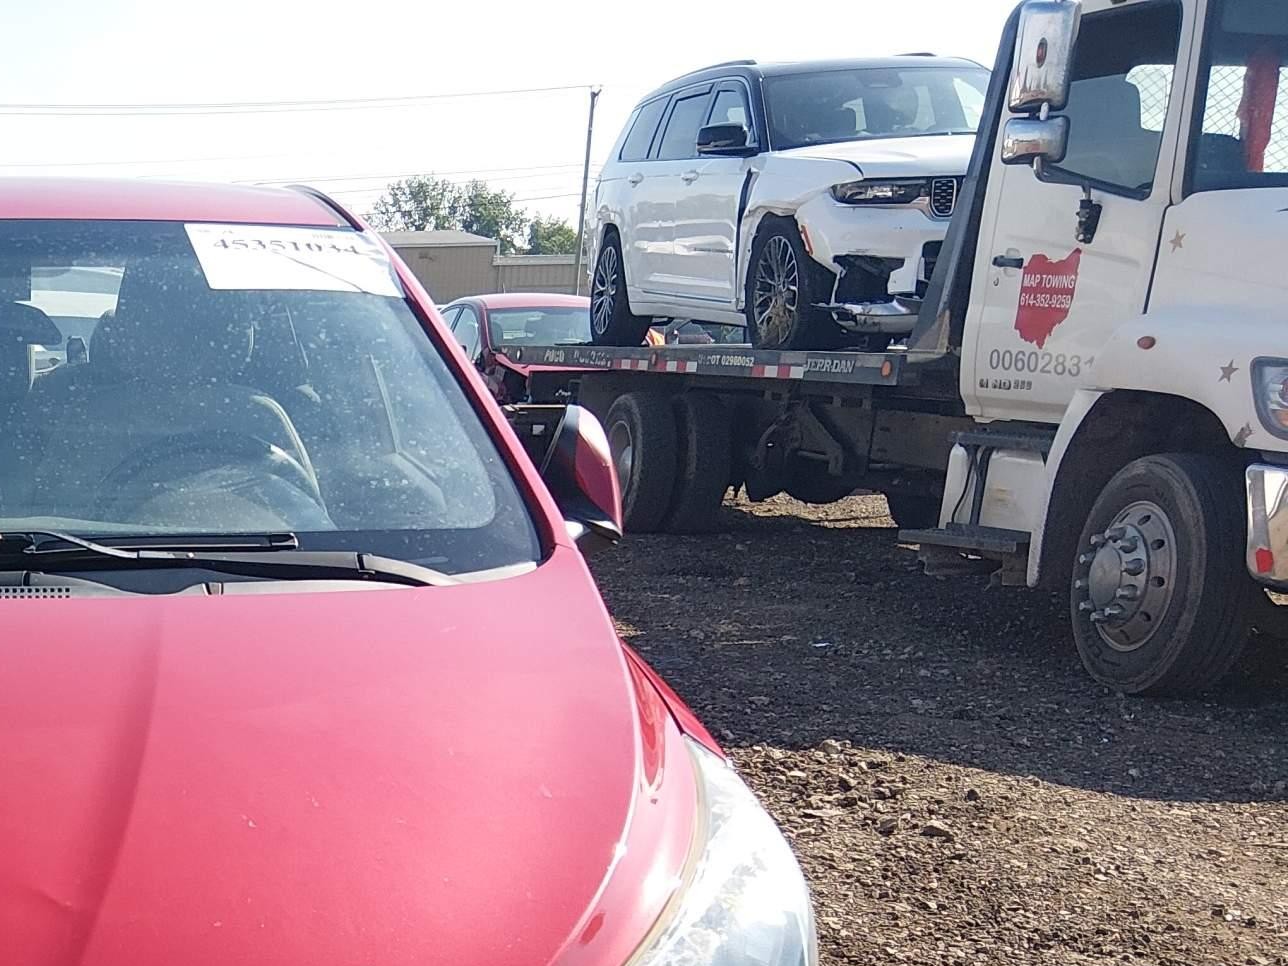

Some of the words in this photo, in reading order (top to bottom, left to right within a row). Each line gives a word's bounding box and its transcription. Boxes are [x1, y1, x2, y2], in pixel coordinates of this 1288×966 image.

[213, 237, 360, 255] 45351034
[1022, 274, 1041, 287] MAP
[1042, 275, 1076, 289] TOWING
